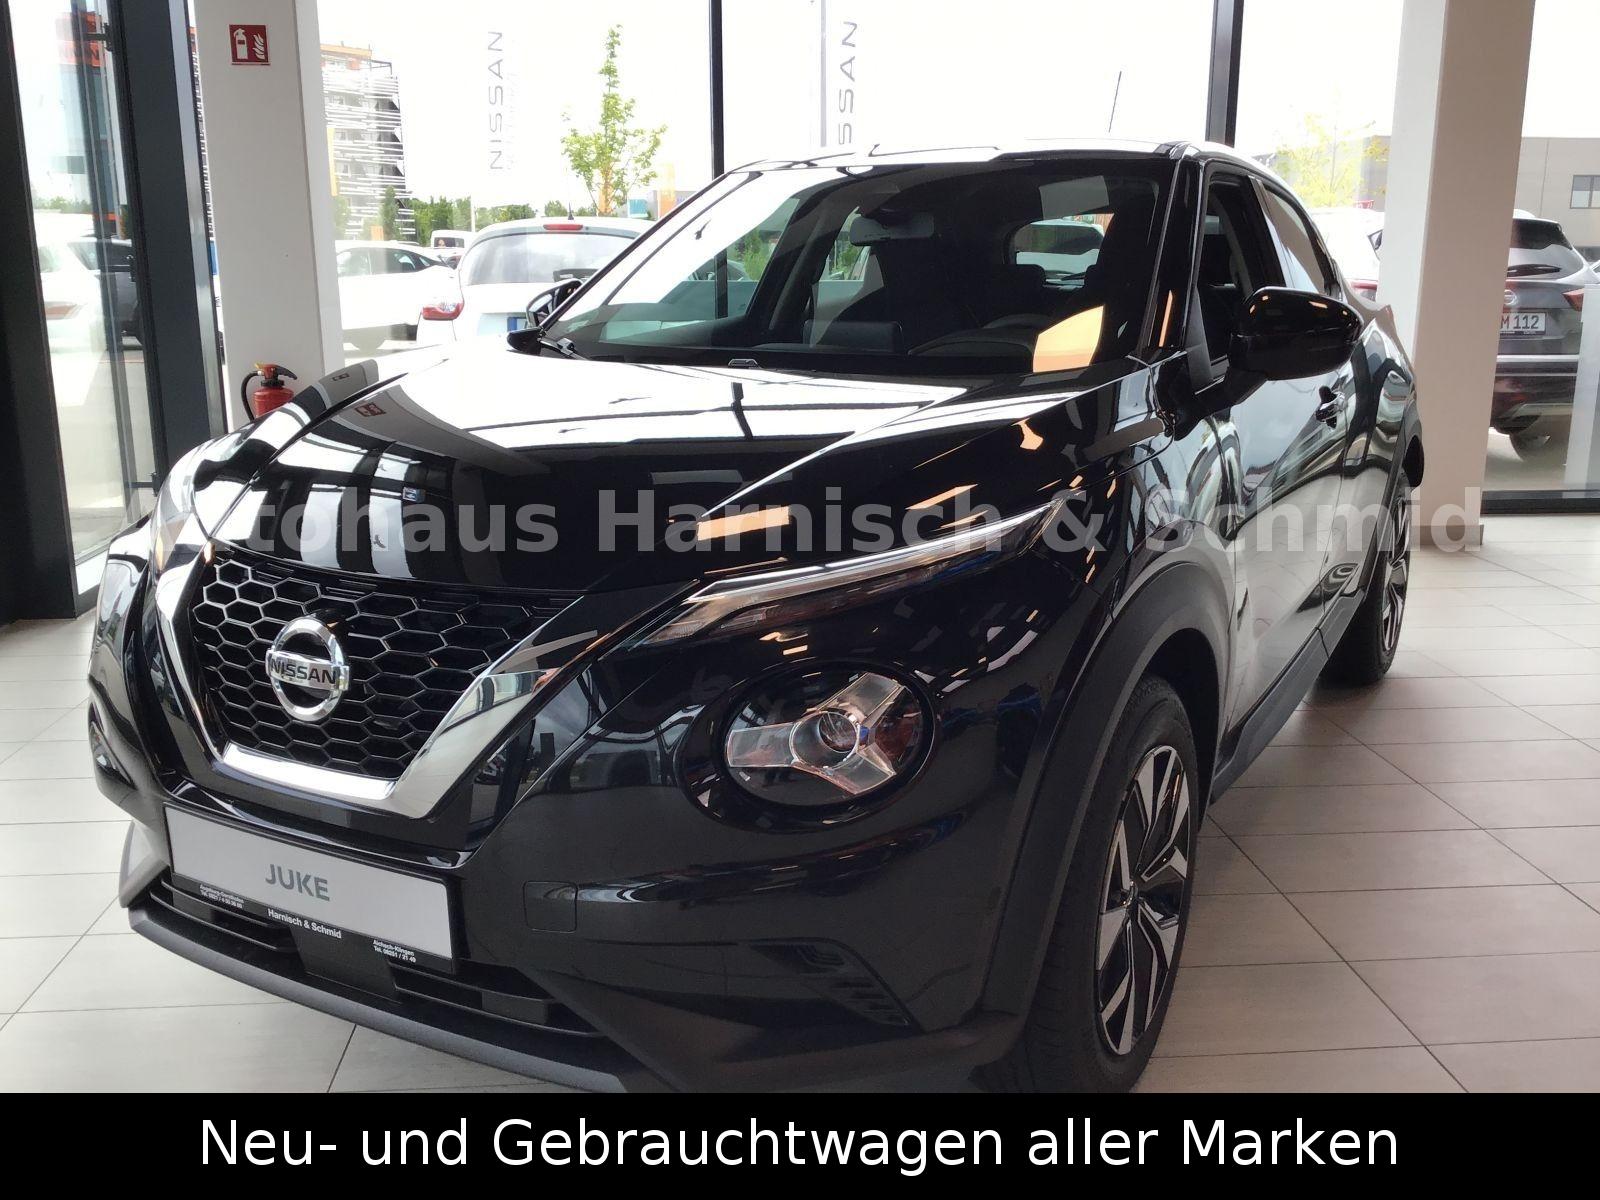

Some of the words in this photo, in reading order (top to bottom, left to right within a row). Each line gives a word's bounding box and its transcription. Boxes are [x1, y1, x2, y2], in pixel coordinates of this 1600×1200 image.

[487, 31, 503, 170] NISSAN
[1513, 315, 1539, 329] 112
[270, 658, 336, 685] NISSAN
[265, 863, 330, 902] JUKE
[267, 908, 303, 927] Harnisch
[303, 919, 311, 930] &
[311, 922, 342, 939] Schmid
